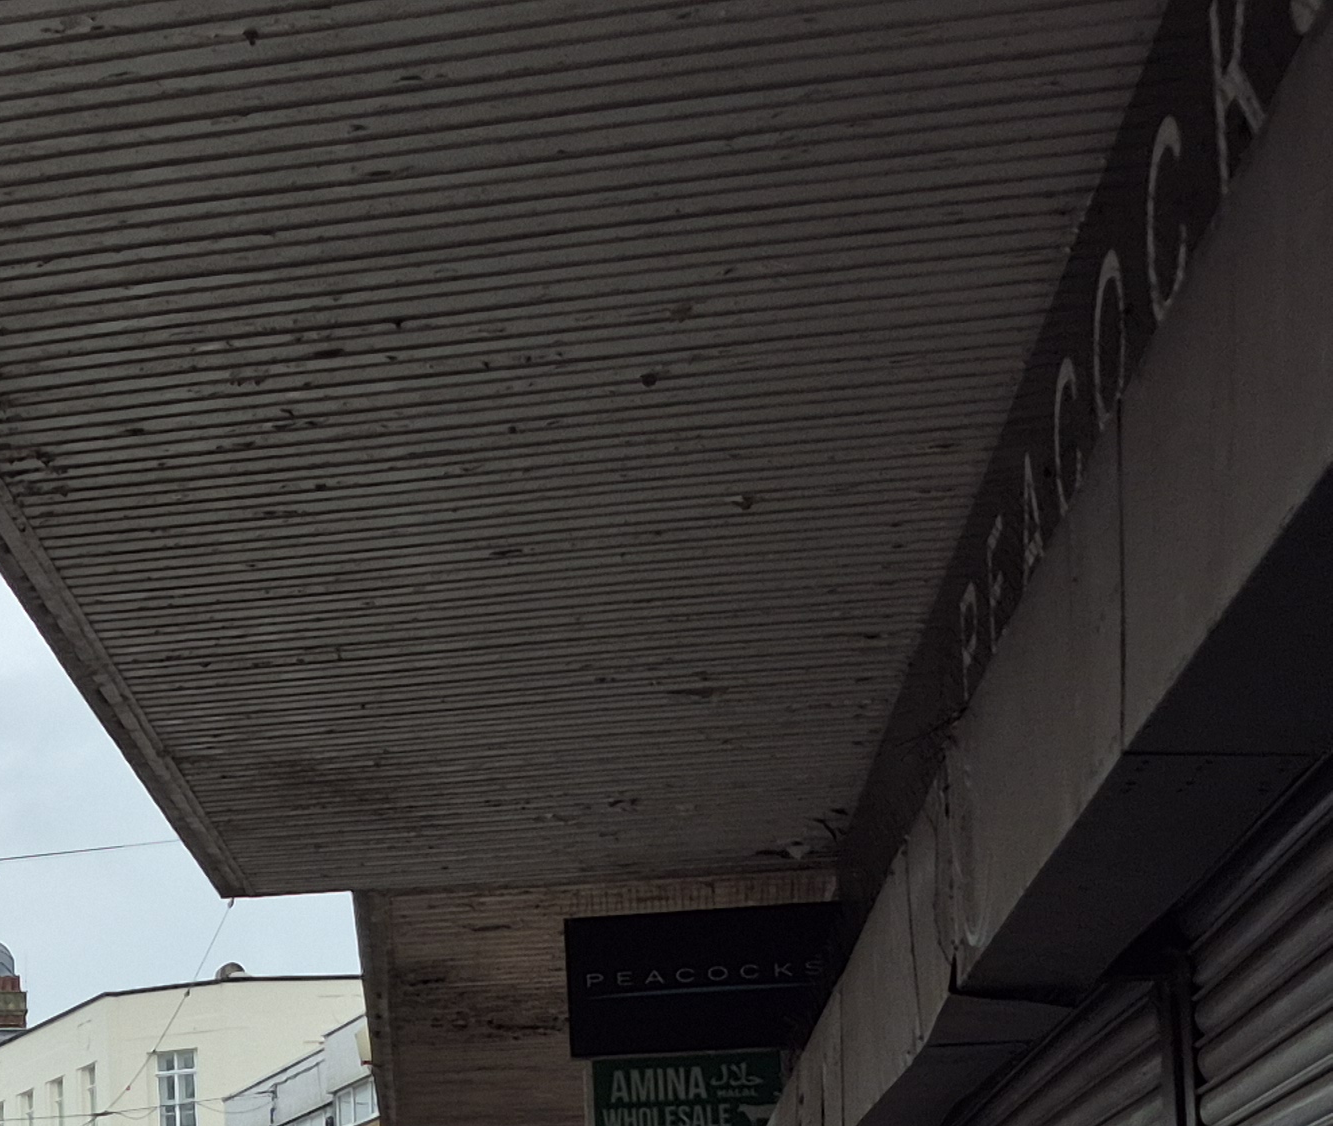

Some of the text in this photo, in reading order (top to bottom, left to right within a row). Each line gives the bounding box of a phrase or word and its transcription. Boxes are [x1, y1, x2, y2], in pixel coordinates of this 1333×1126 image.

[960, 0, 1321, 701] PEACOCK
[585, 959, 825, 988] PEACOCKS
[610, 1065, 708, 1103] AMINA
[710, 1061, 764, 1086] حلال
[717, 1088, 758, 1098] HALAL
